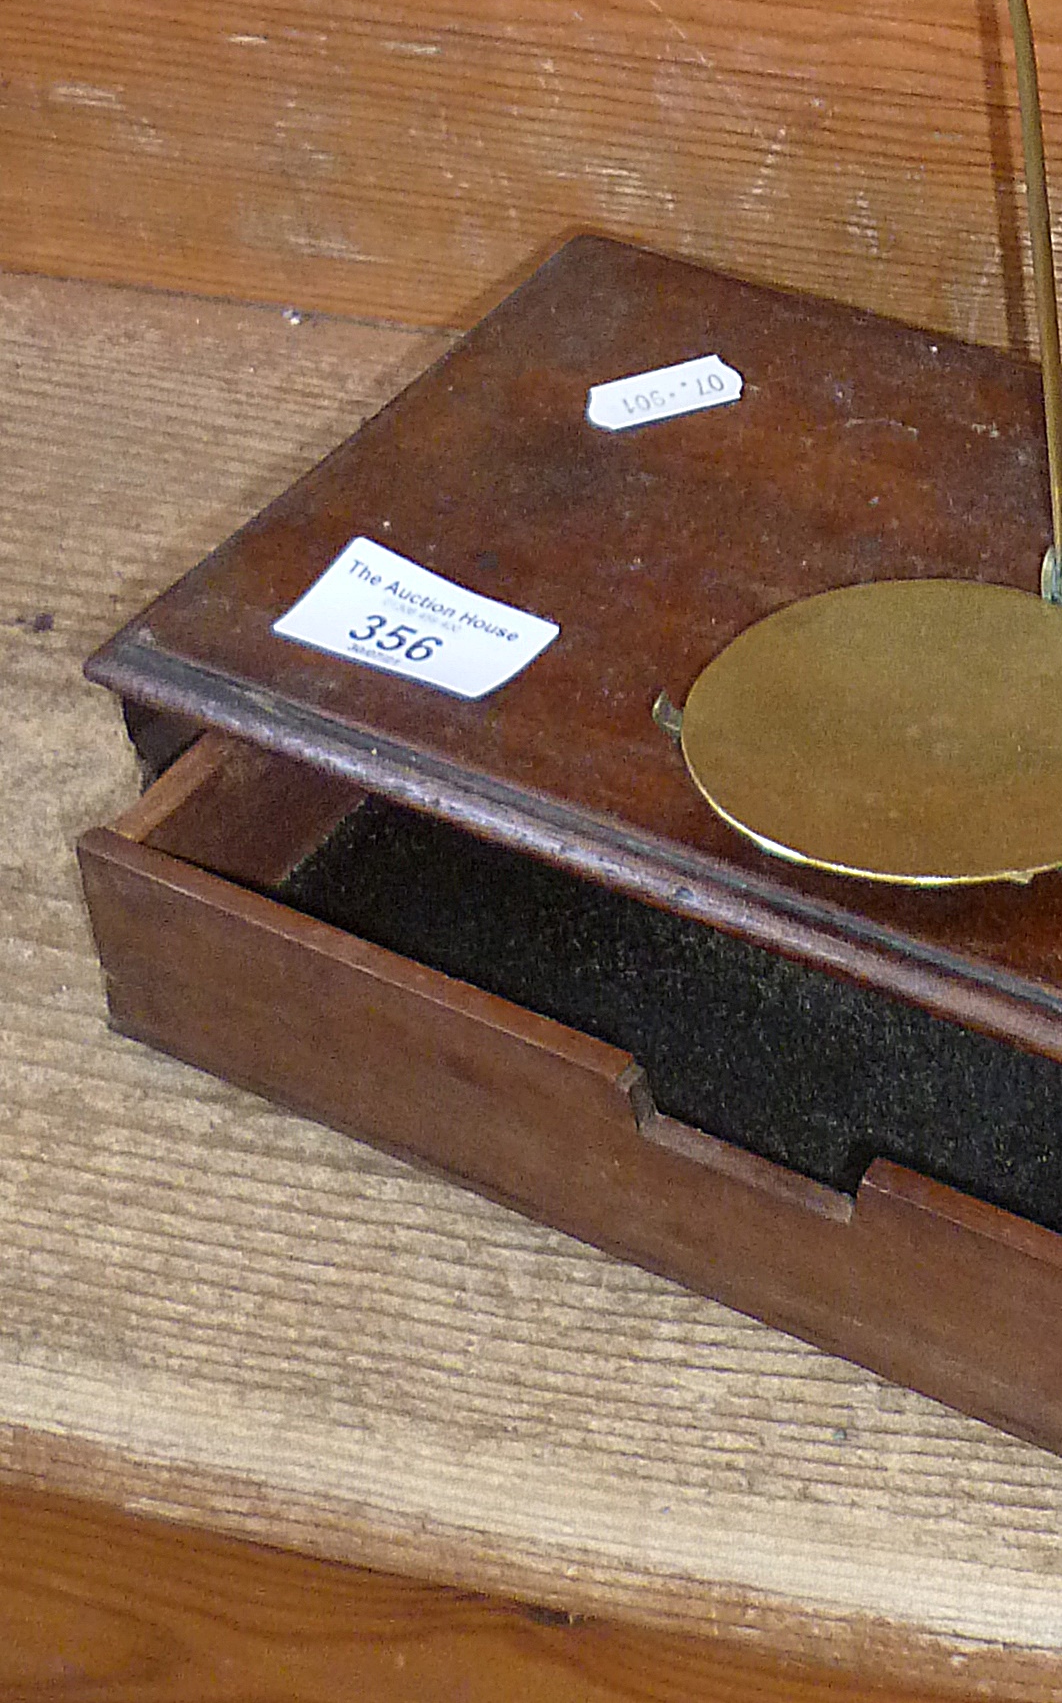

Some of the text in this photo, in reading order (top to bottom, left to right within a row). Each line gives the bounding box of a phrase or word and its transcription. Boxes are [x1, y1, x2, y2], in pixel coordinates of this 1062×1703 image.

[348, 559, 382, 587] The
[385, 580, 457, 618] Auction
[459, 612, 520, 643] House
[348, 615, 443, 662] 356
